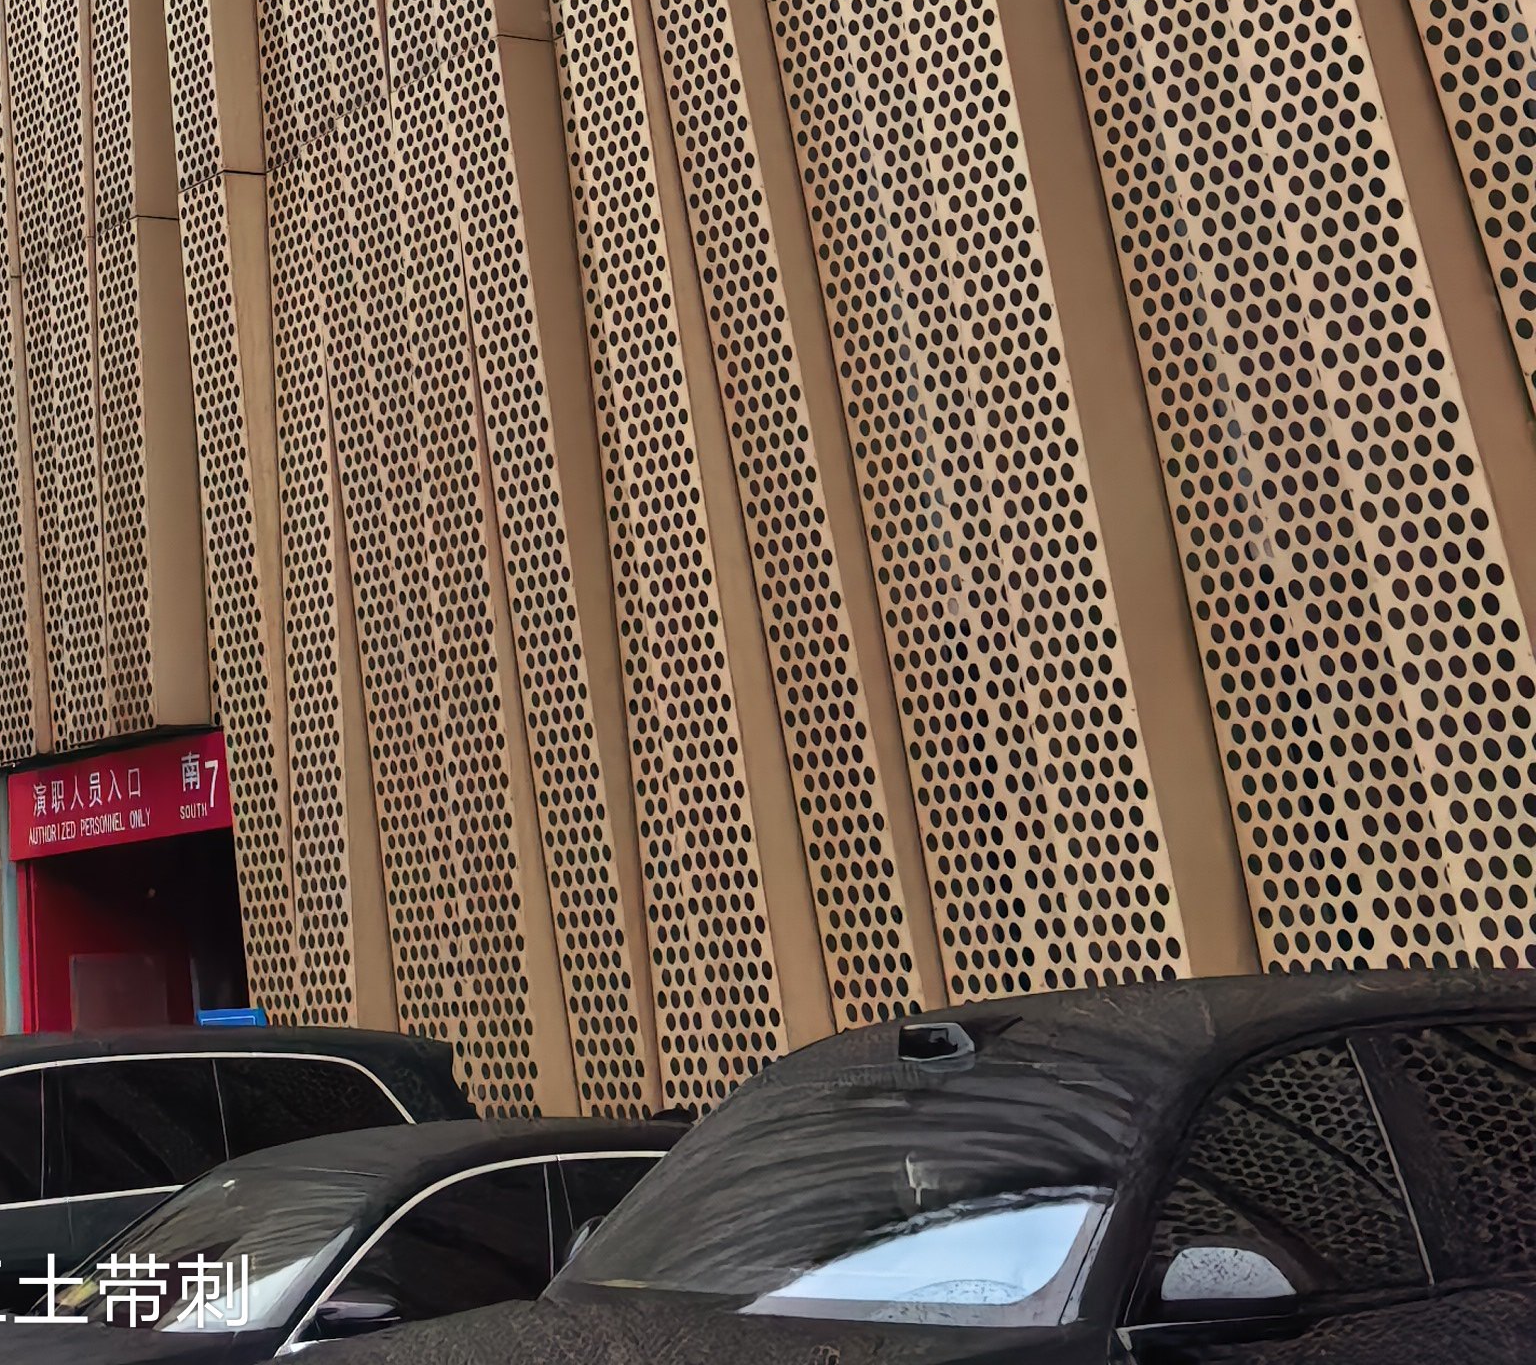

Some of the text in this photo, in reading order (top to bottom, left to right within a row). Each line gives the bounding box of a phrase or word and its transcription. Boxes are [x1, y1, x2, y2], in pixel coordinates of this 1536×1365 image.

[32, 768, 142, 818] 演职人员入口
[28, 802, 208, 846] AUTHORIZED PERSONNEL ONLY SOUTH
